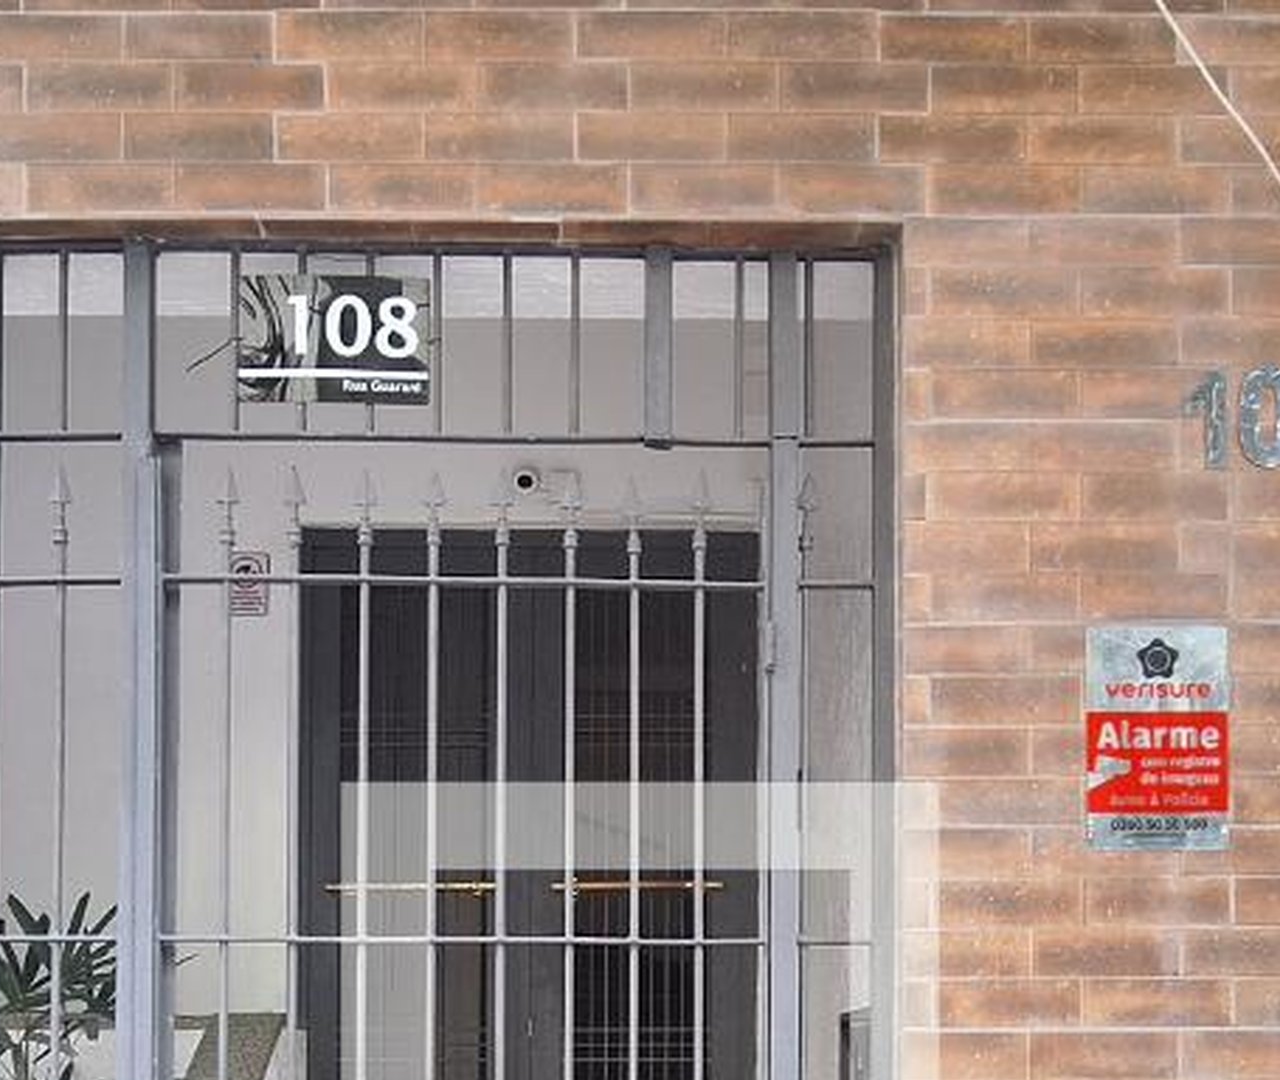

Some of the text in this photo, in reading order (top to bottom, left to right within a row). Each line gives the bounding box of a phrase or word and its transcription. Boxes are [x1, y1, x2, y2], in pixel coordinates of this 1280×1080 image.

[286, 293, 420, 359] 108
[342, 378, 369, 393] Rua
[1105, 681, 1211, 699] verisure
[1097, 721, 1220, 750] Alarme
